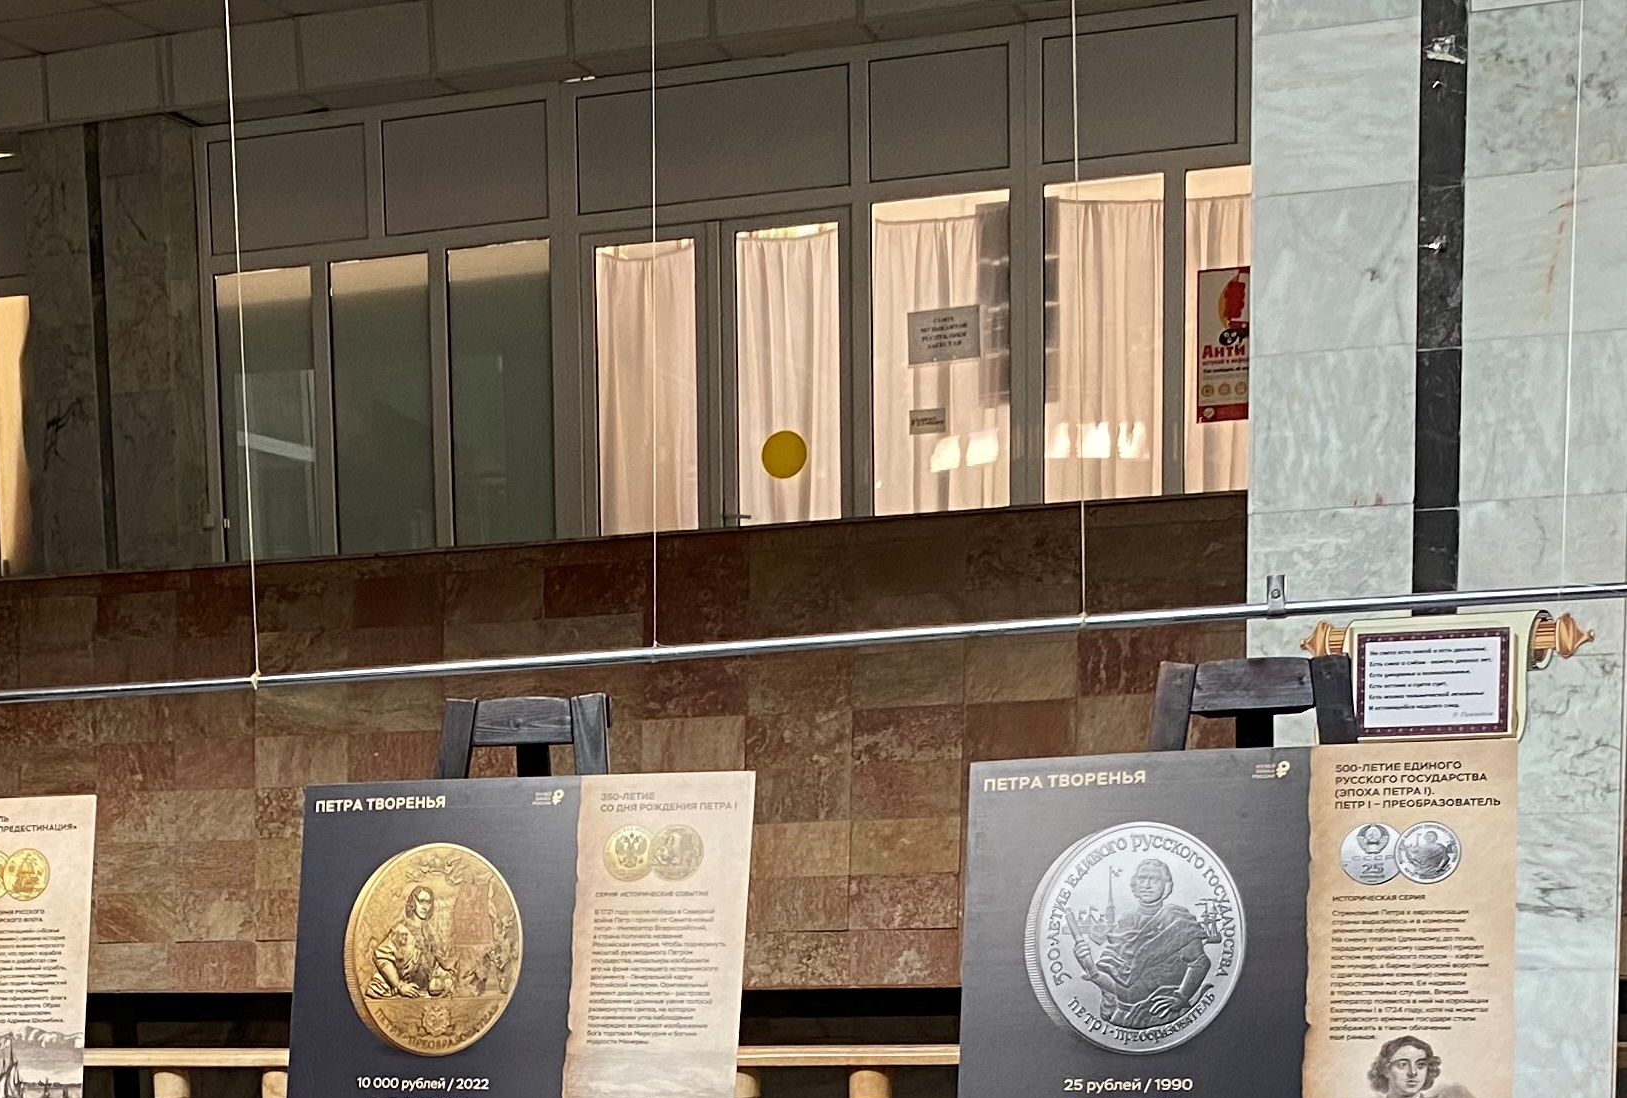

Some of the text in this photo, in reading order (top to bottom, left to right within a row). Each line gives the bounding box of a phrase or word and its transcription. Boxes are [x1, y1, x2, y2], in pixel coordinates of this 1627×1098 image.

[1335, 761, 1462, 773] 500-ЛЕТИЕ ЕДИНОГО
[984, 770, 1146, 792] ПЕТРА ТВОРЕНЬЯ
[1336, 773, 1488, 784] РУССКОГО ГОСУДАРСТВА
[601, 792, 655, 801] 350-ЛЕТИЕ
[1335, 788, 1380, 798] (ЭПОХА
[1383, 787, 1421, 796] ПЕТРА
[315, 795, 446, 813] ПЕТРА ТВОРЕНЬЯ
[600, 804, 614, 812] СО
[616, 804, 638, 812] ДНЯ
[639, 802, 697, 812] РОЖДЕНИЯ
[700, 802, 732, 810] ПЕТРА
[1335, 801, 1365, 810] ПЕТР
[1383, 798, 1501, 808] ПРЕОБРАЗОВАТЕЛЬ
[1130, 833, 1206, 870] РУССКОГО
[1362, 864, 1384, 875] 25
[357, 1077, 371, 1088] 10
[373, 1077, 399, 1089] 000
[402, 1078, 446, 1092] рублей
[456, 1078, 489, 1090] 2022
[1064, 1078, 1083, 1091] 25
[1086, 1078, 1142, 1094] рублей
[1154, 1078, 1194, 1091] 1990
